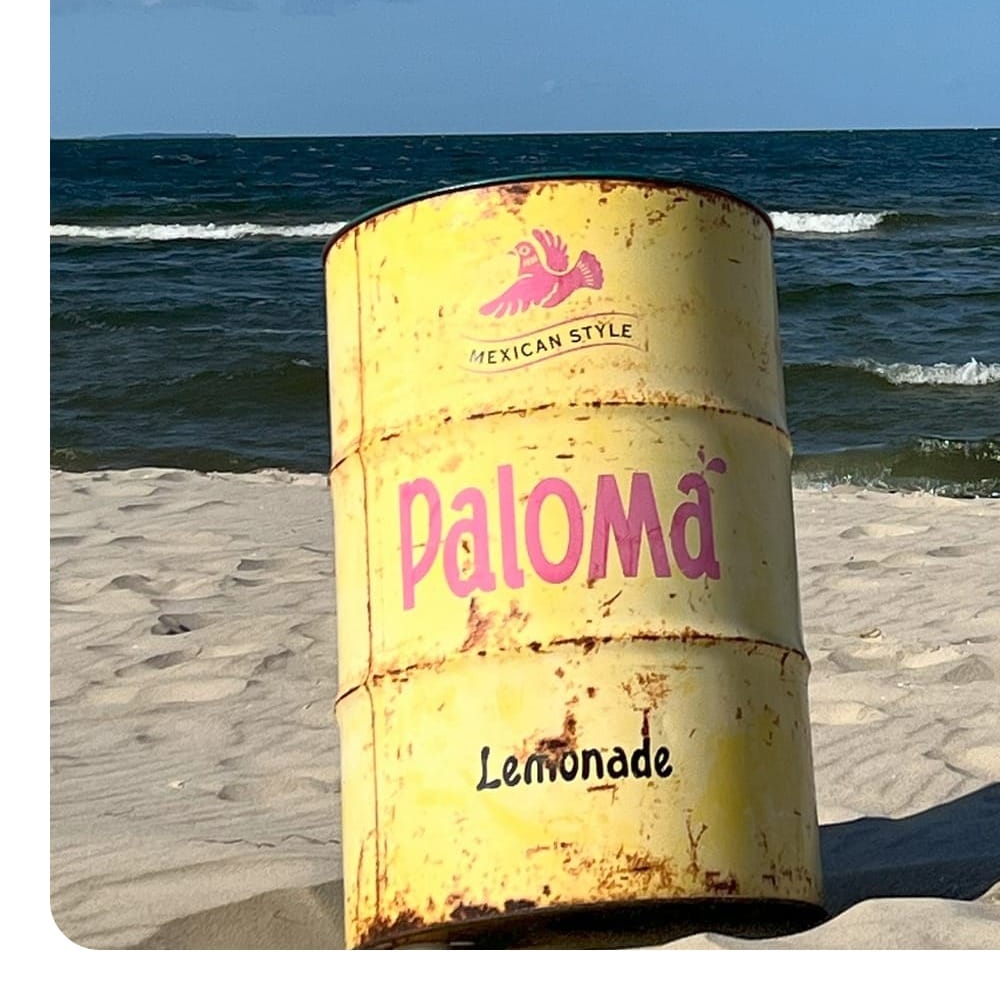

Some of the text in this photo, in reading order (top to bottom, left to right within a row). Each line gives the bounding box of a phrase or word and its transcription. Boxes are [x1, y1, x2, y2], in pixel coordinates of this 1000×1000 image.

[469, 322, 632, 365] MEXICAN STYLE
[476, 736, 673, 791] Lemonade
